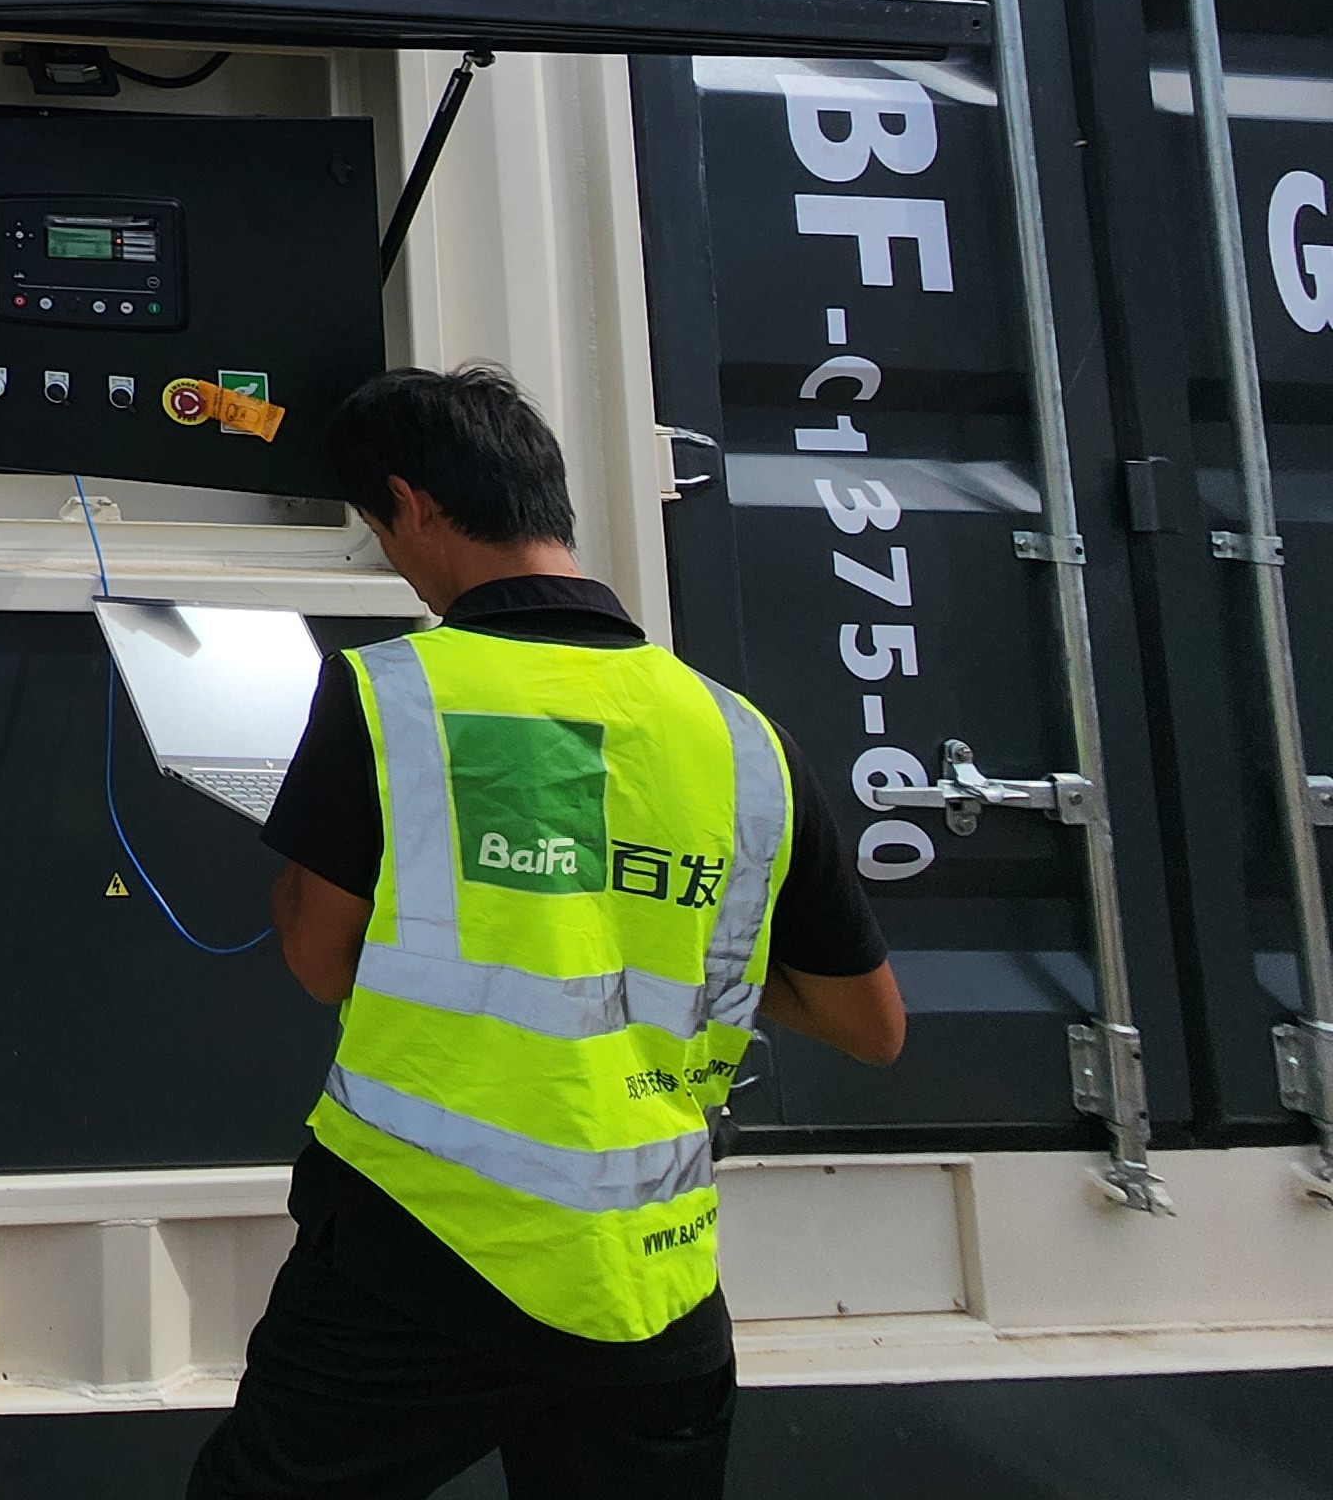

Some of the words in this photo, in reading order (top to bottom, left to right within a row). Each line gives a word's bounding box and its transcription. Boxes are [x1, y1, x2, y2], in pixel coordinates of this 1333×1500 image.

[775, 74, 954, 881] BF-C1375-60
[478, 831, 578, 875] BaiFa
[611, 838, 725, 909] 百发
